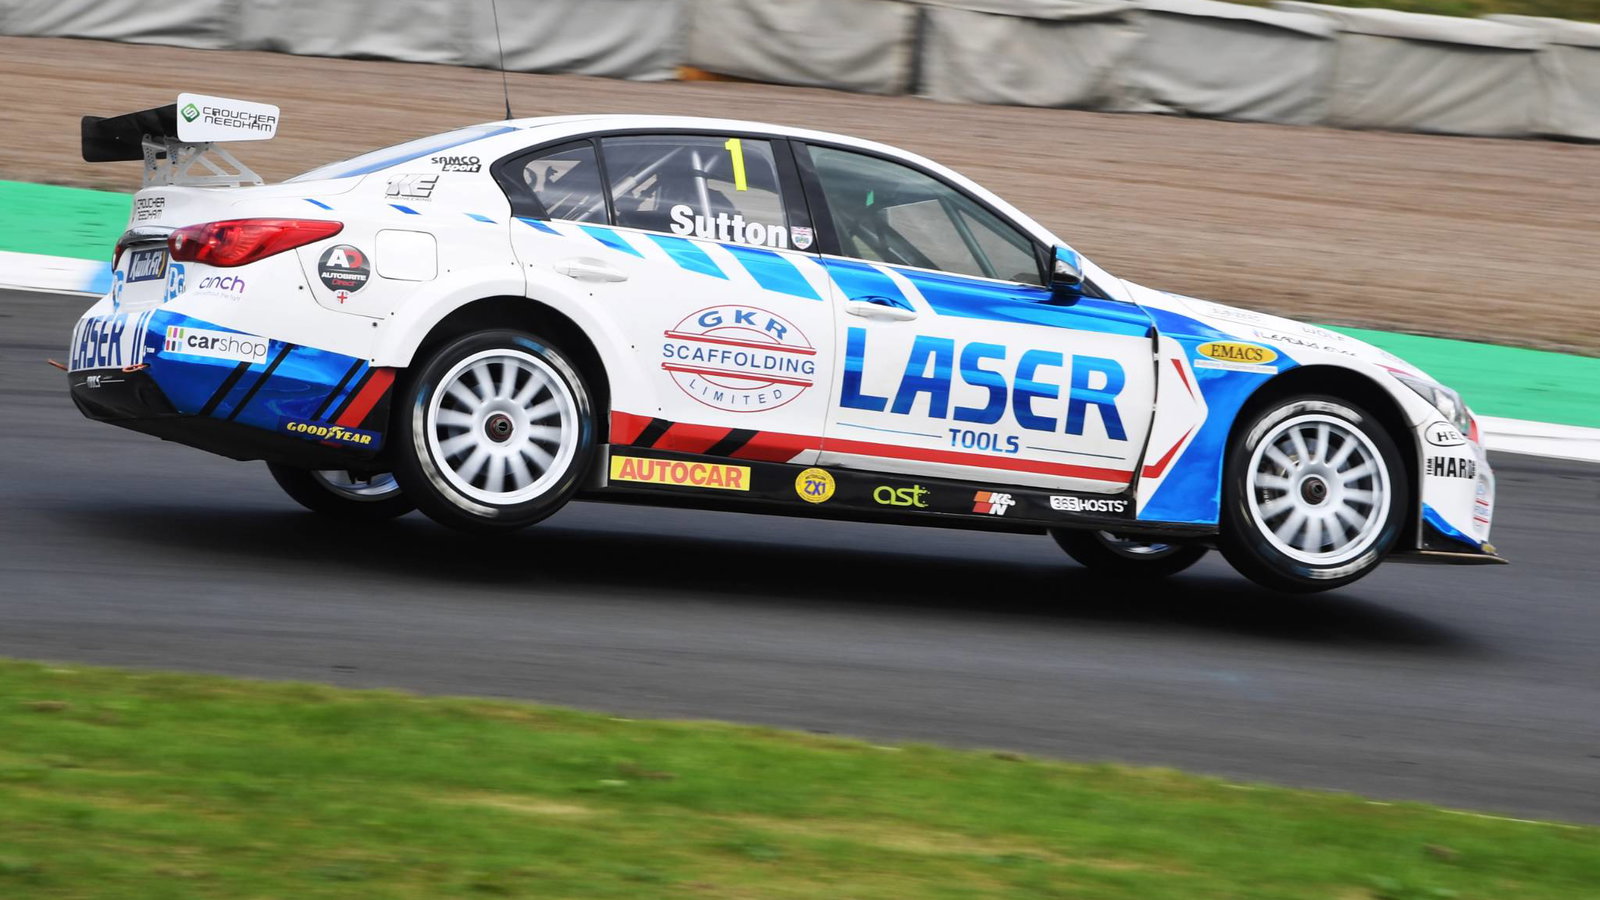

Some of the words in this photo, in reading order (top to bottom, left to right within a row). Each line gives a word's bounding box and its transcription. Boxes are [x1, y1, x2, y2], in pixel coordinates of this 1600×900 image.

[202, 106, 276, 124] CROUCHER
[204, 115, 272, 132] NEEDHAM
[431, 156, 480, 165] SAMCO
[724, 138, 747, 191] 1
[670, 204, 788, 249] Sutton
[199, 275, 245, 293] cinch
[321, 271, 367, 281] AUTOBRITE
[697, 309, 788, 340] GKR
[72, 313, 128, 371] LASER
[187, 334, 266, 360] carshop
[1211, 344, 1264, 361] EMACS
[662, 343, 815, 375] SCAFFOLDING
[689, 378, 783, 405] LIMITED
[839, 326, 1128, 442] LASER
[286, 421, 373, 445] GOODYEAR
[949, 428, 1019, 454] TOOLS
[618, 457, 743, 489] AUTOCAR
